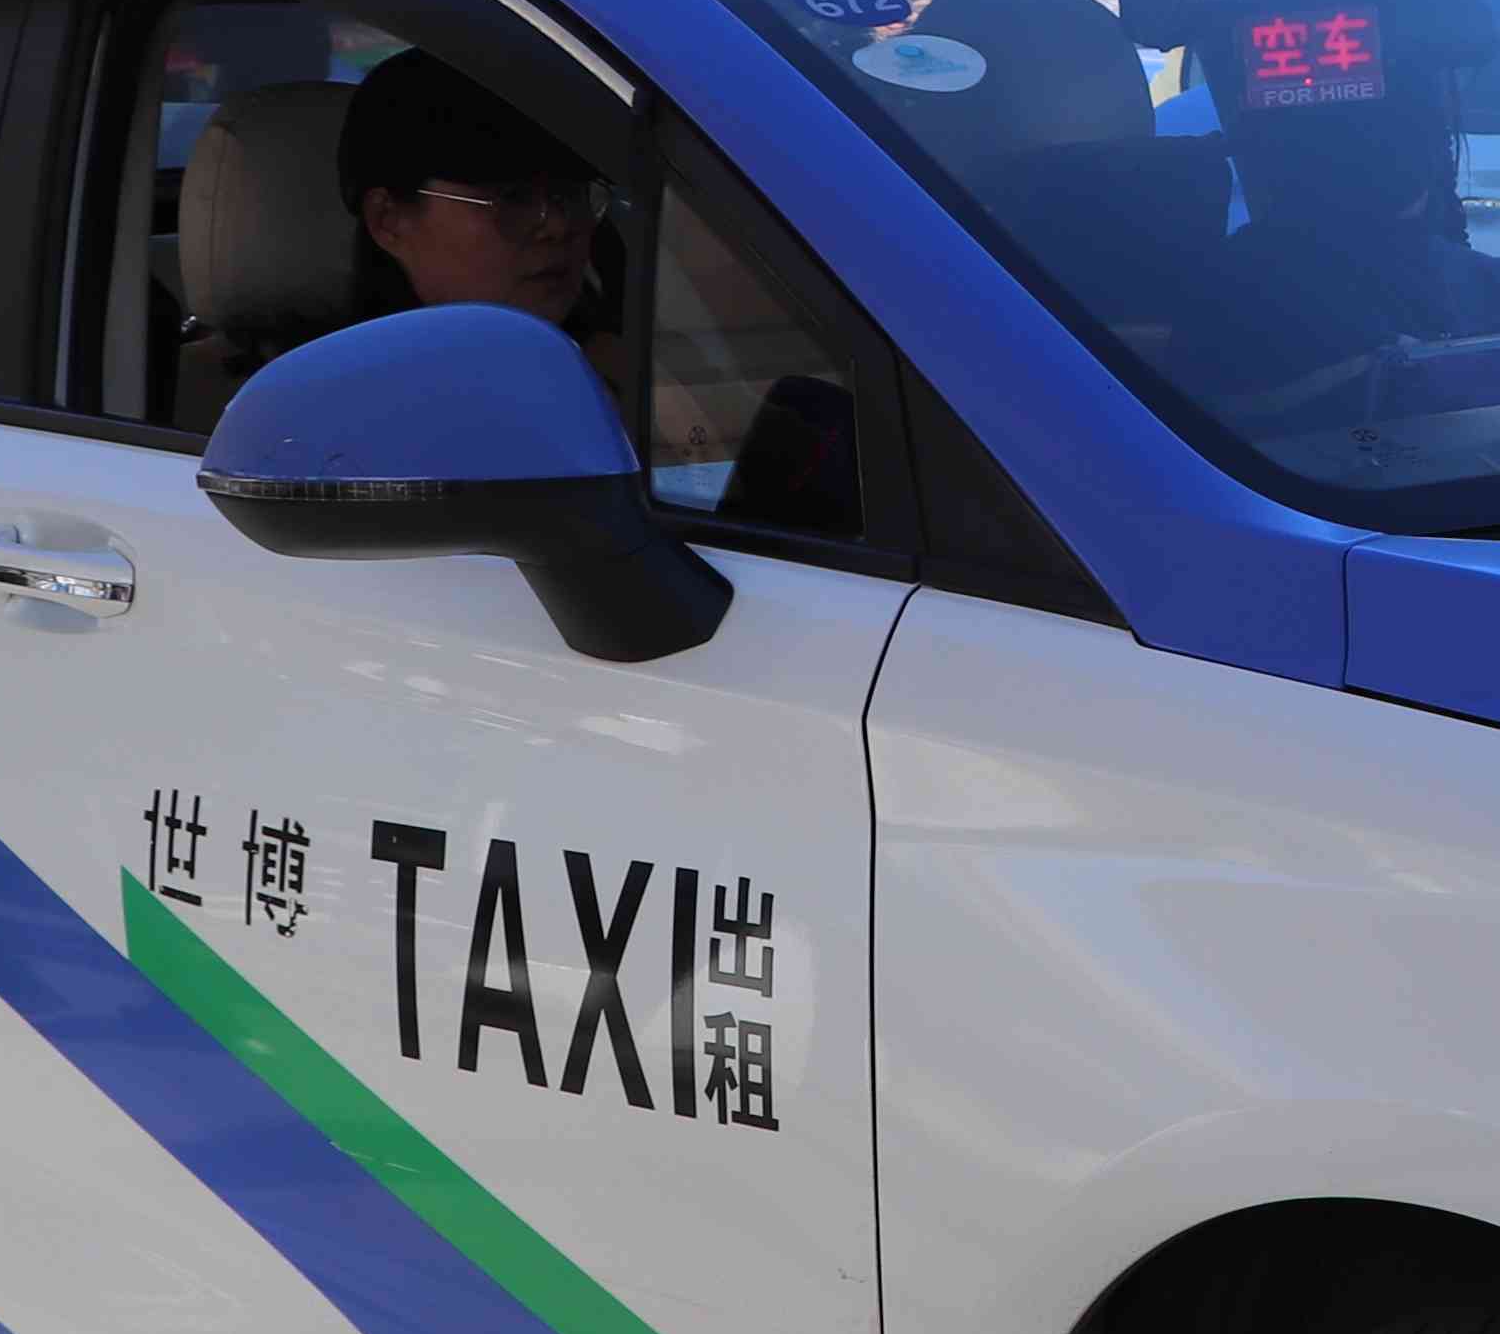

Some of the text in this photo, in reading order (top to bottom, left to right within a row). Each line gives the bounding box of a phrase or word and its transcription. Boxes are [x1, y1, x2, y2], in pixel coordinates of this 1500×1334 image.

[1252, 12, 1373, 78] 空车
[1264, 82, 1375, 106] FOR HIRE
[143, 788, 310, 938] 世博
[370, 819, 700, 1120] TAXI
[701, 875, 780, 1132] 出租
